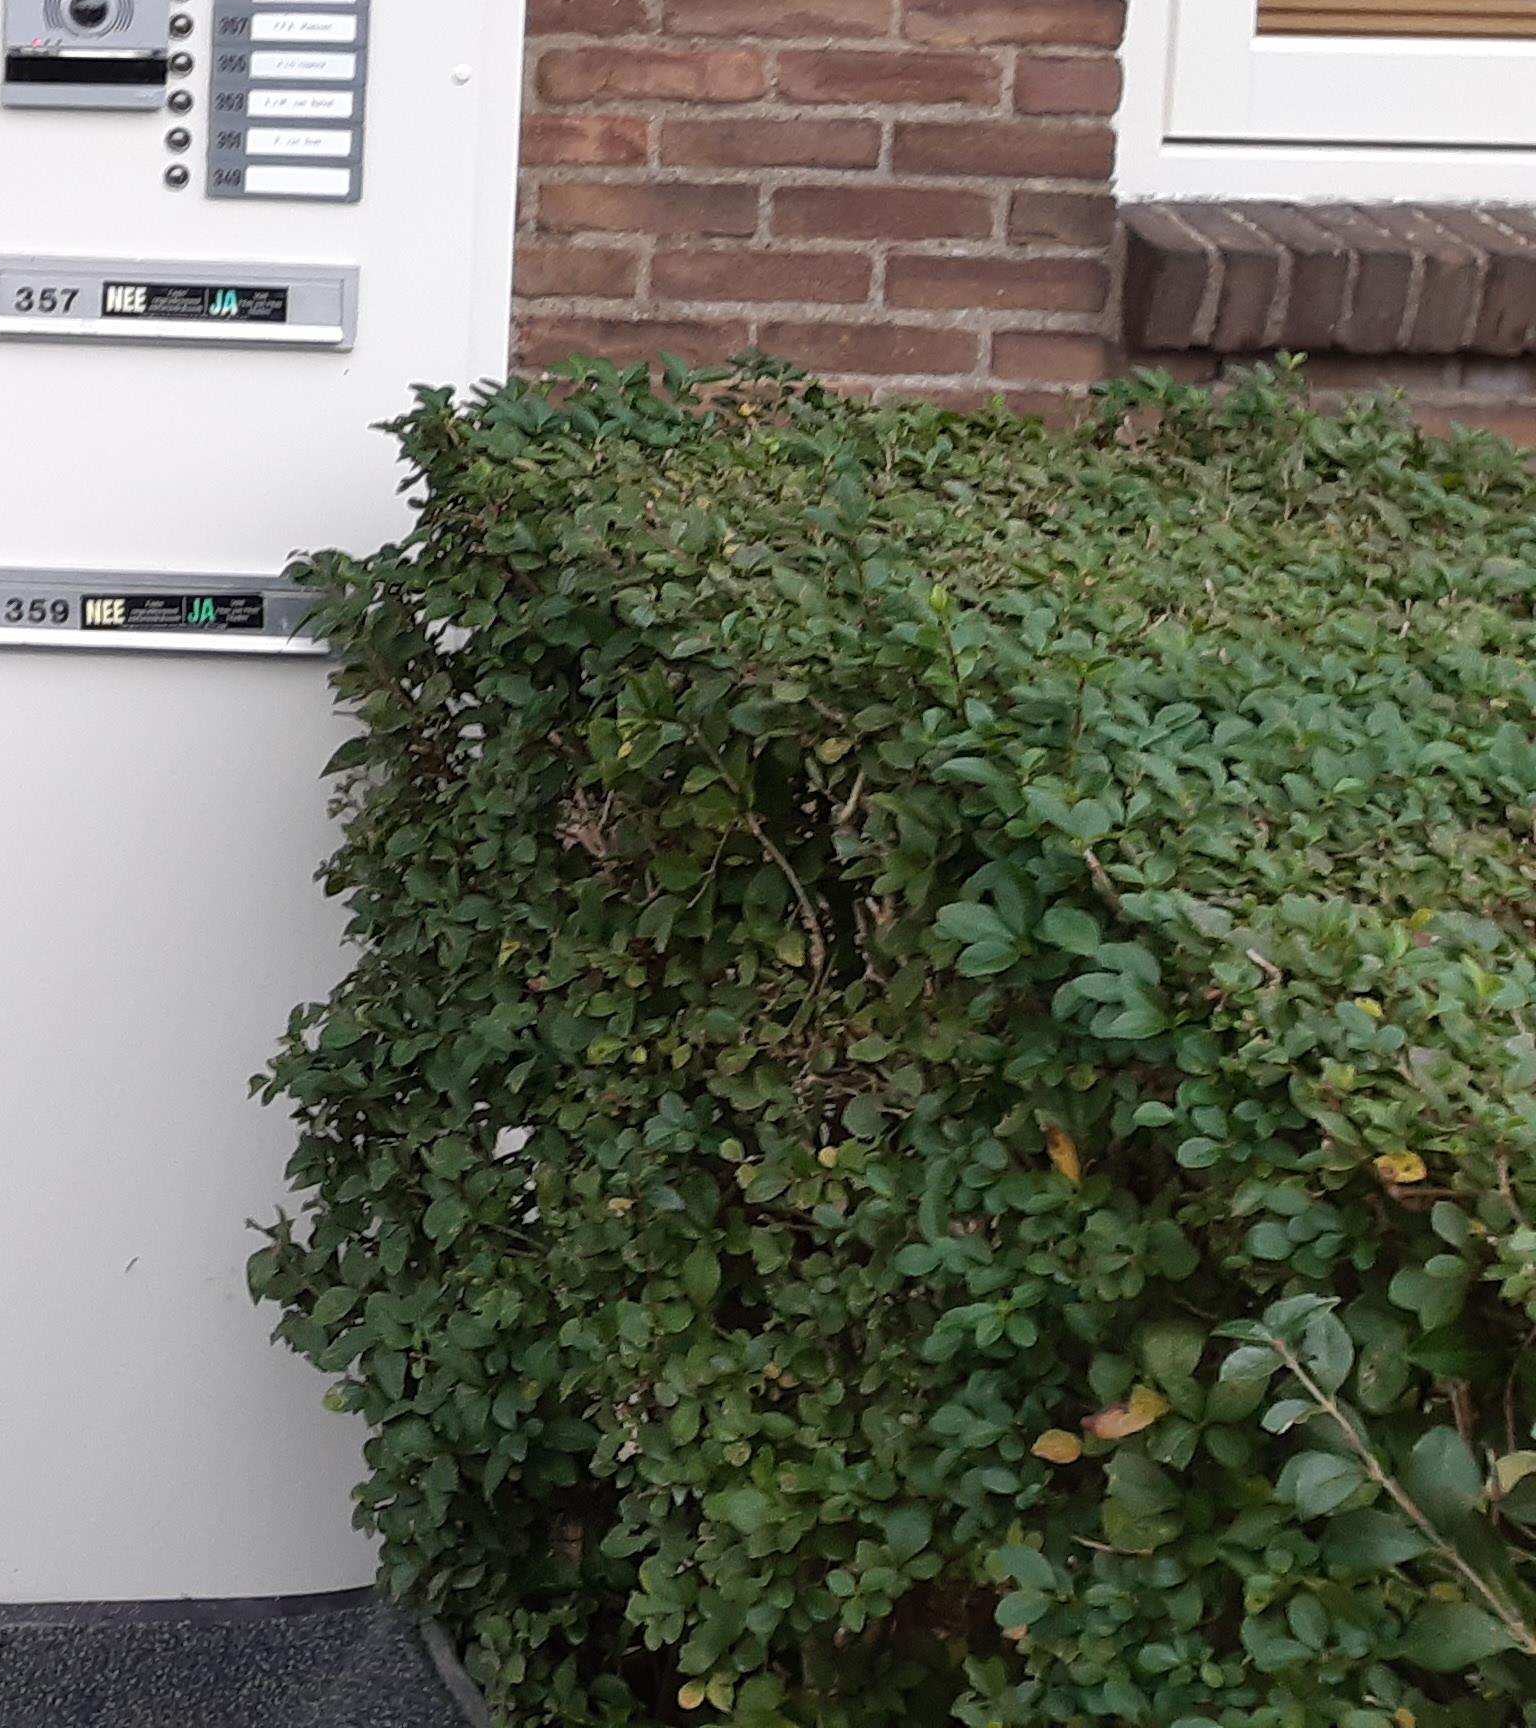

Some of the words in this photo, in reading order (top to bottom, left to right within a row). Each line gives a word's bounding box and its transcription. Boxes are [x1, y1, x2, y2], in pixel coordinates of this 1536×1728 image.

[218, 16, 248, 35] 357
[217, 54, 247, 73] 355
[214, 92, 244, 112] 353
[216, 130, 242, 149] 351
[213, 168, 241, 186] 349
[14, 285, 80, 314] 357
[105, 285, 148, 314] NEE
[209, 288, 239, 317] JA
[4, 597, 70, 624] 359
[84, 597, 127, 626] NEE
[187, 597, 218, 625] JA
